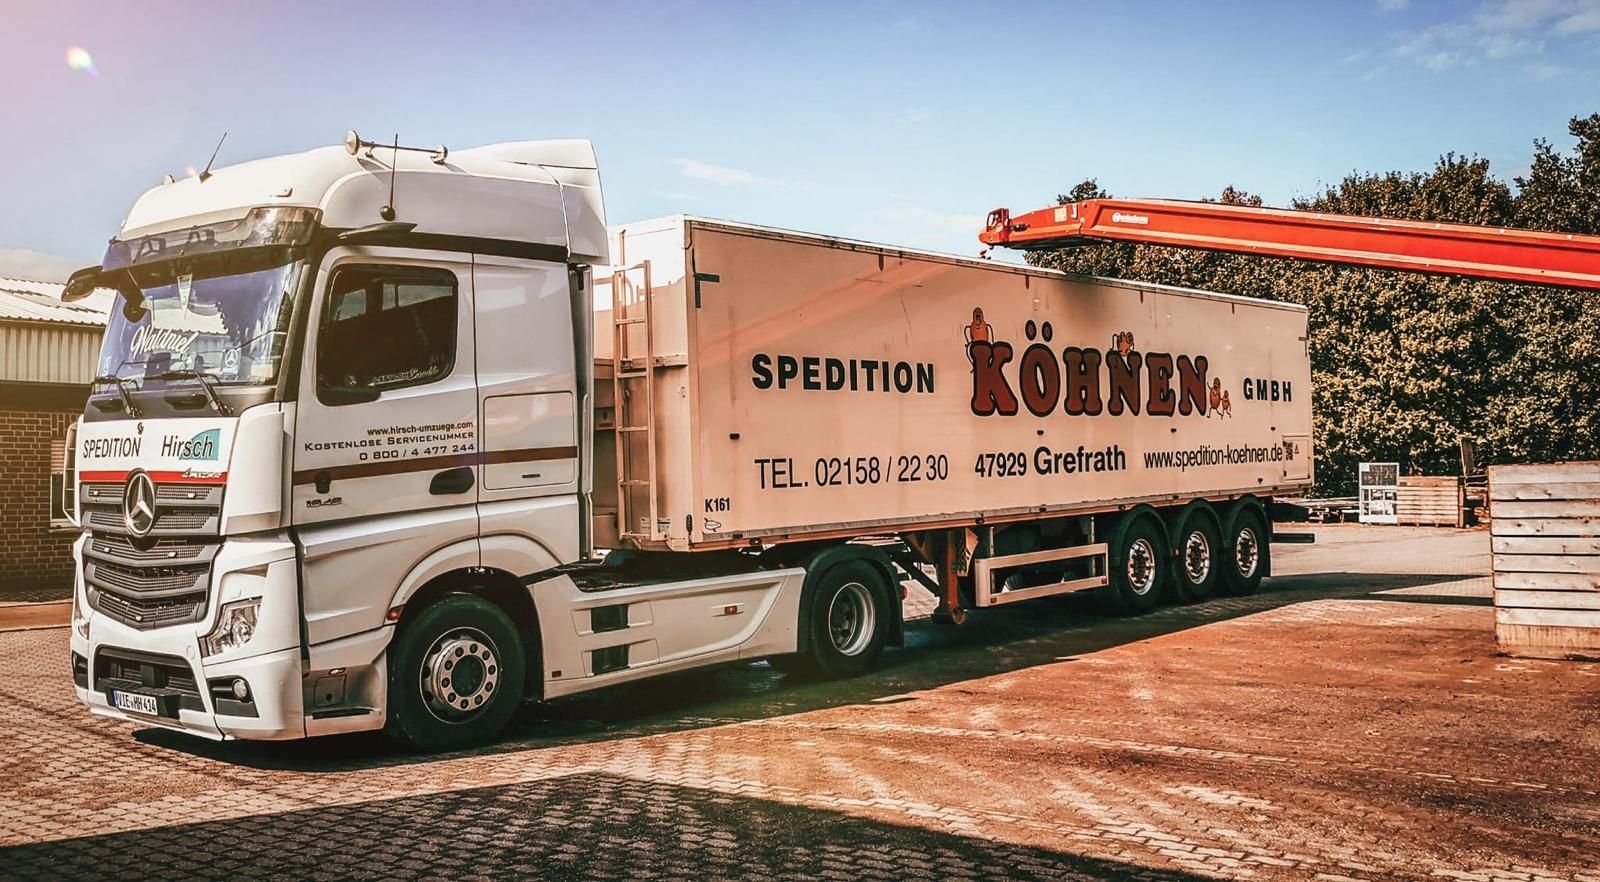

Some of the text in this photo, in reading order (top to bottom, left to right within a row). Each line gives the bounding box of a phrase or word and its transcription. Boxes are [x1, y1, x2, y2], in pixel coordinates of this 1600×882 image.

[752, 319, 1293, 417] SPEDITION KÖHNEN GMBH
[367, 421, 474, 436] www.hirsch-umzuege.com
[83, 435, 213, 459] SPEDITION Hirsch
[373, 450, 399, 459] 800
[411, 448, 419, 457] 4
[424, 447, 447, 455] 477
[452, 443, 475, 453] 244
[1144, 442, 1283, 472] www.spedition-koehnen.de
[754, 458, 809, 489] TEL.
[815, 456, 881, 487] 02158
[975, 445, 1127, 478] 47929 Grefrath
[705, 497, 730, 512] K161
